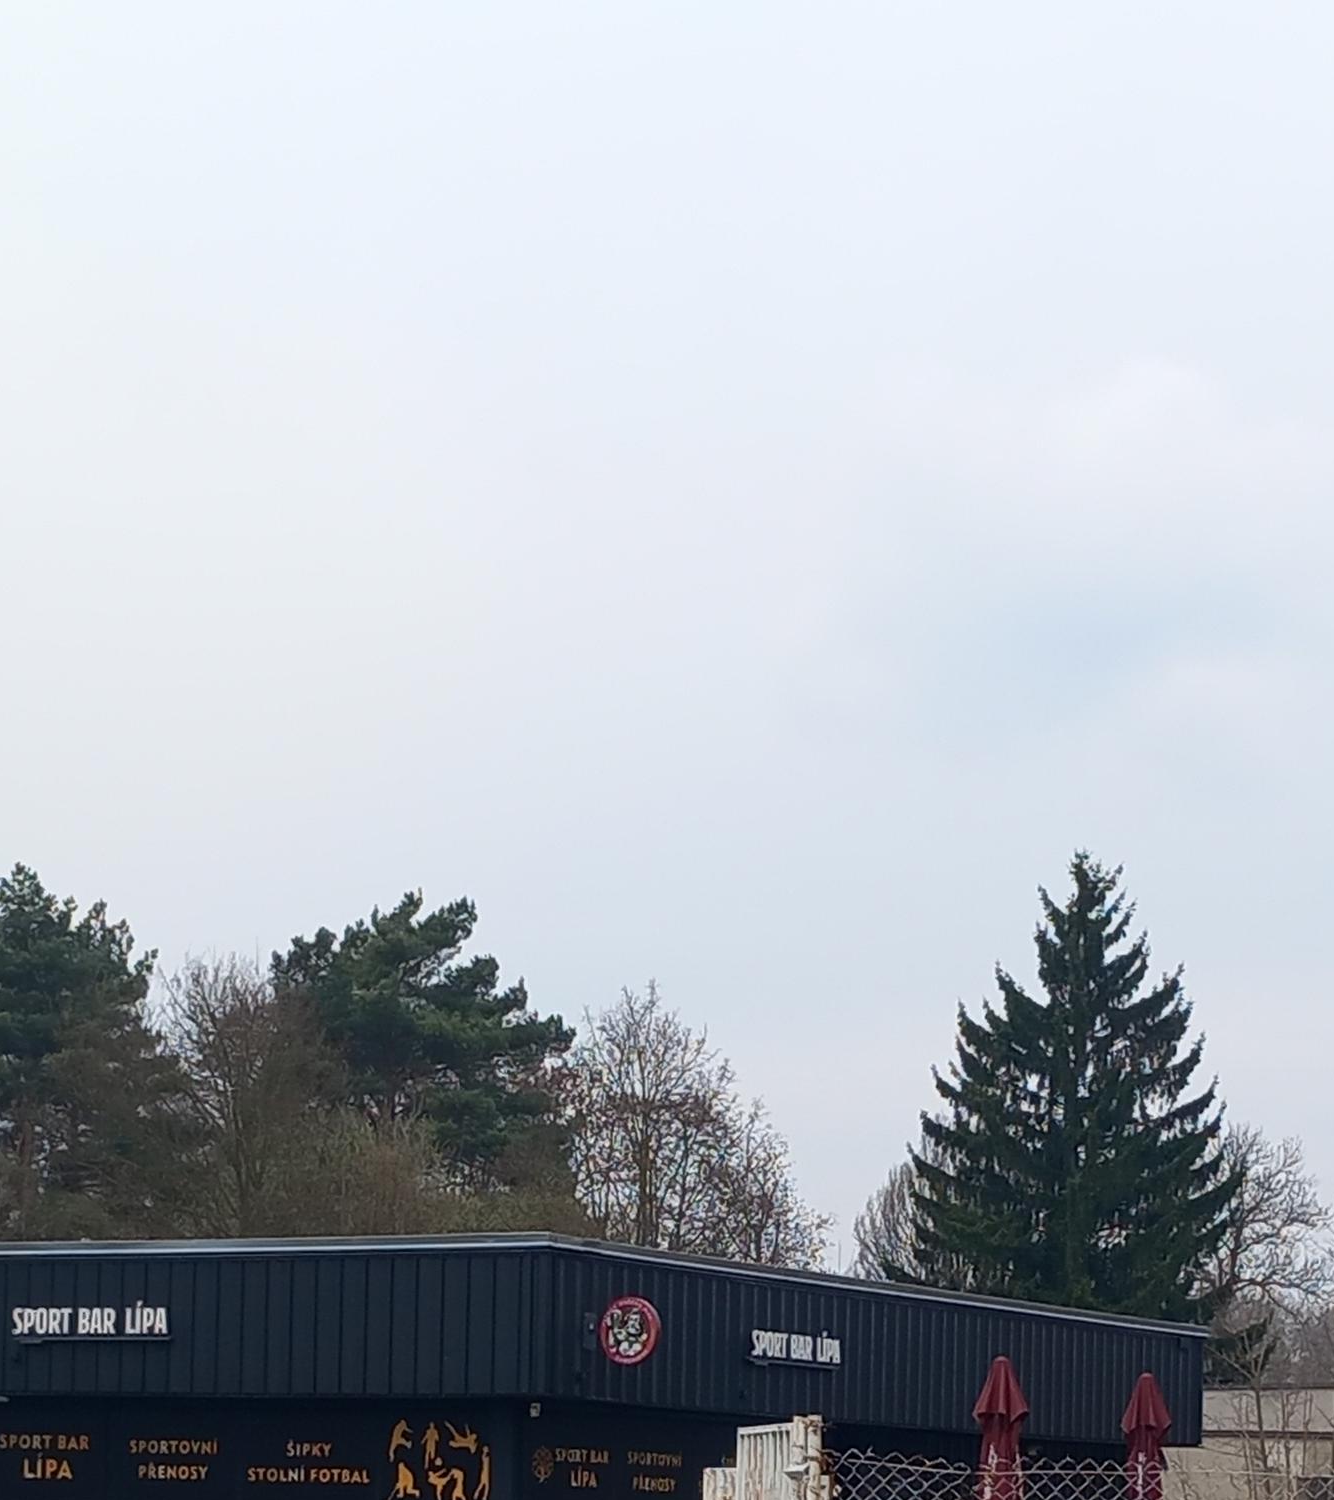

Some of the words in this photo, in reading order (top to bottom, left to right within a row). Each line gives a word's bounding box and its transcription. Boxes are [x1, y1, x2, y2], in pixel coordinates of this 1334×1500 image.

[11, 1307, 72, 1335] SPORT
[78, 1307, 116, 1335] BAR
[125, 1300, 168, 1335] LÍPA
[751, 1329, 788, 1359] SPORT
[790, 1334, 813, 1361] BAR
[816, 1331, 841, 1364] LÍPA
[0, 1434, 53, 1450] SPORT
[57, 1434, 90, 1451] BAR
[129, 1438, 218, 1455] SPORTOVNÍ
[286, 1439, 332, 1457] ŠIPKY
[555, 1447, 588, 1463] SPORT
[23, 1453, 73, 1480] LÍPA
[138, 1462, 209, 1480] PŘENOSY
[247, 1465, 306, 1482] STOLNÍ
[310, 1468, 370, 1484] FOTBAL
[571, 1466, 597, 1488] LÍPA
